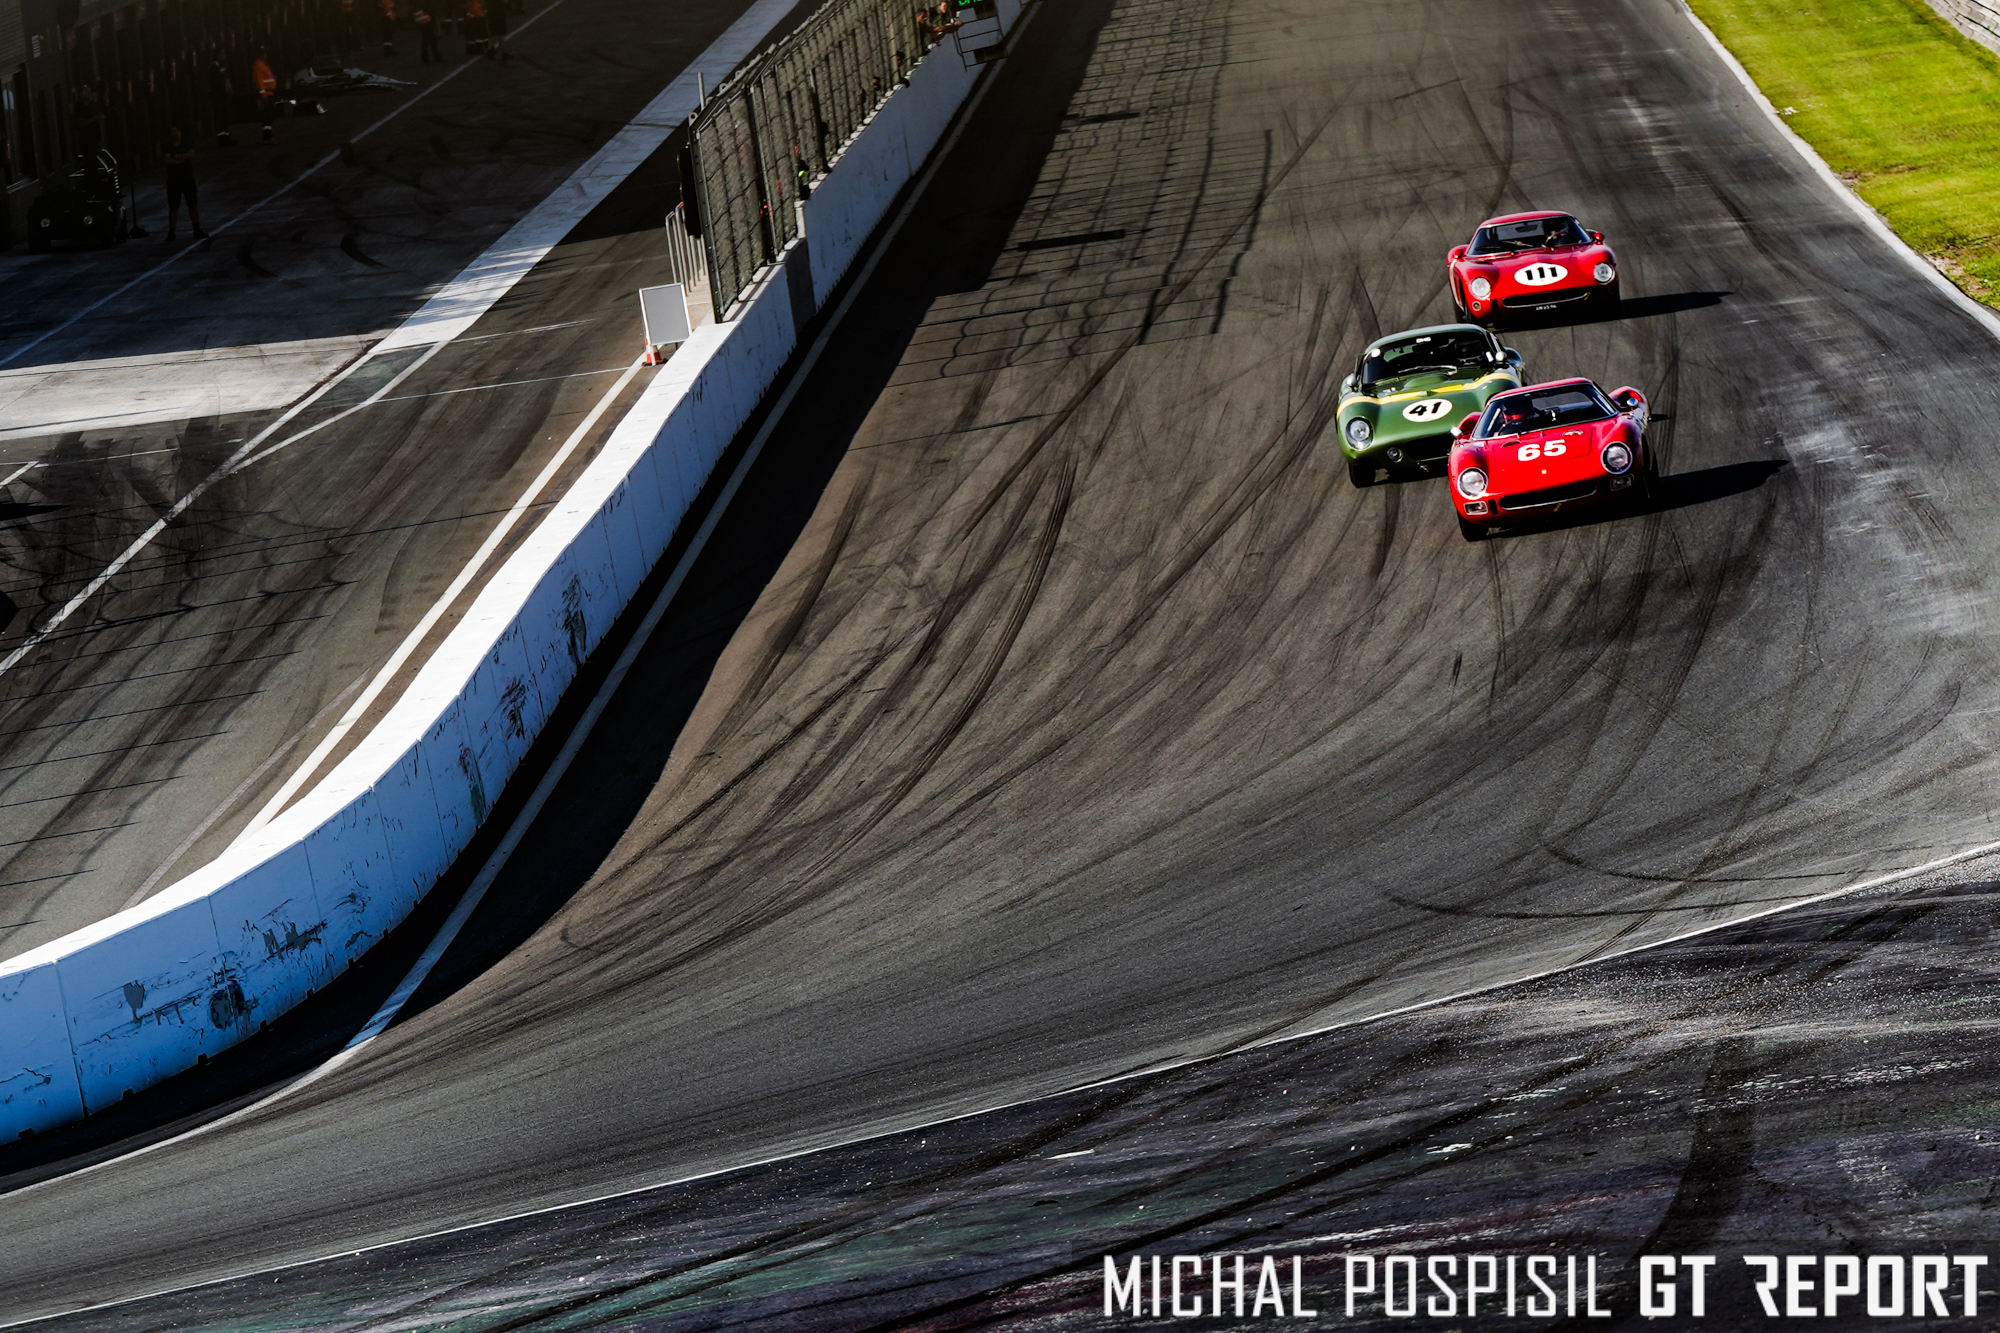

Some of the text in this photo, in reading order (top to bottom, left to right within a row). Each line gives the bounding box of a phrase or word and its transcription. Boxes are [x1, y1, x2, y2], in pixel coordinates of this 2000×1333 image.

[1524, 266, 1558, 281] 111
[1408, 401, 1442, 417] 41
[1517, 438, 1567, 462] 65
